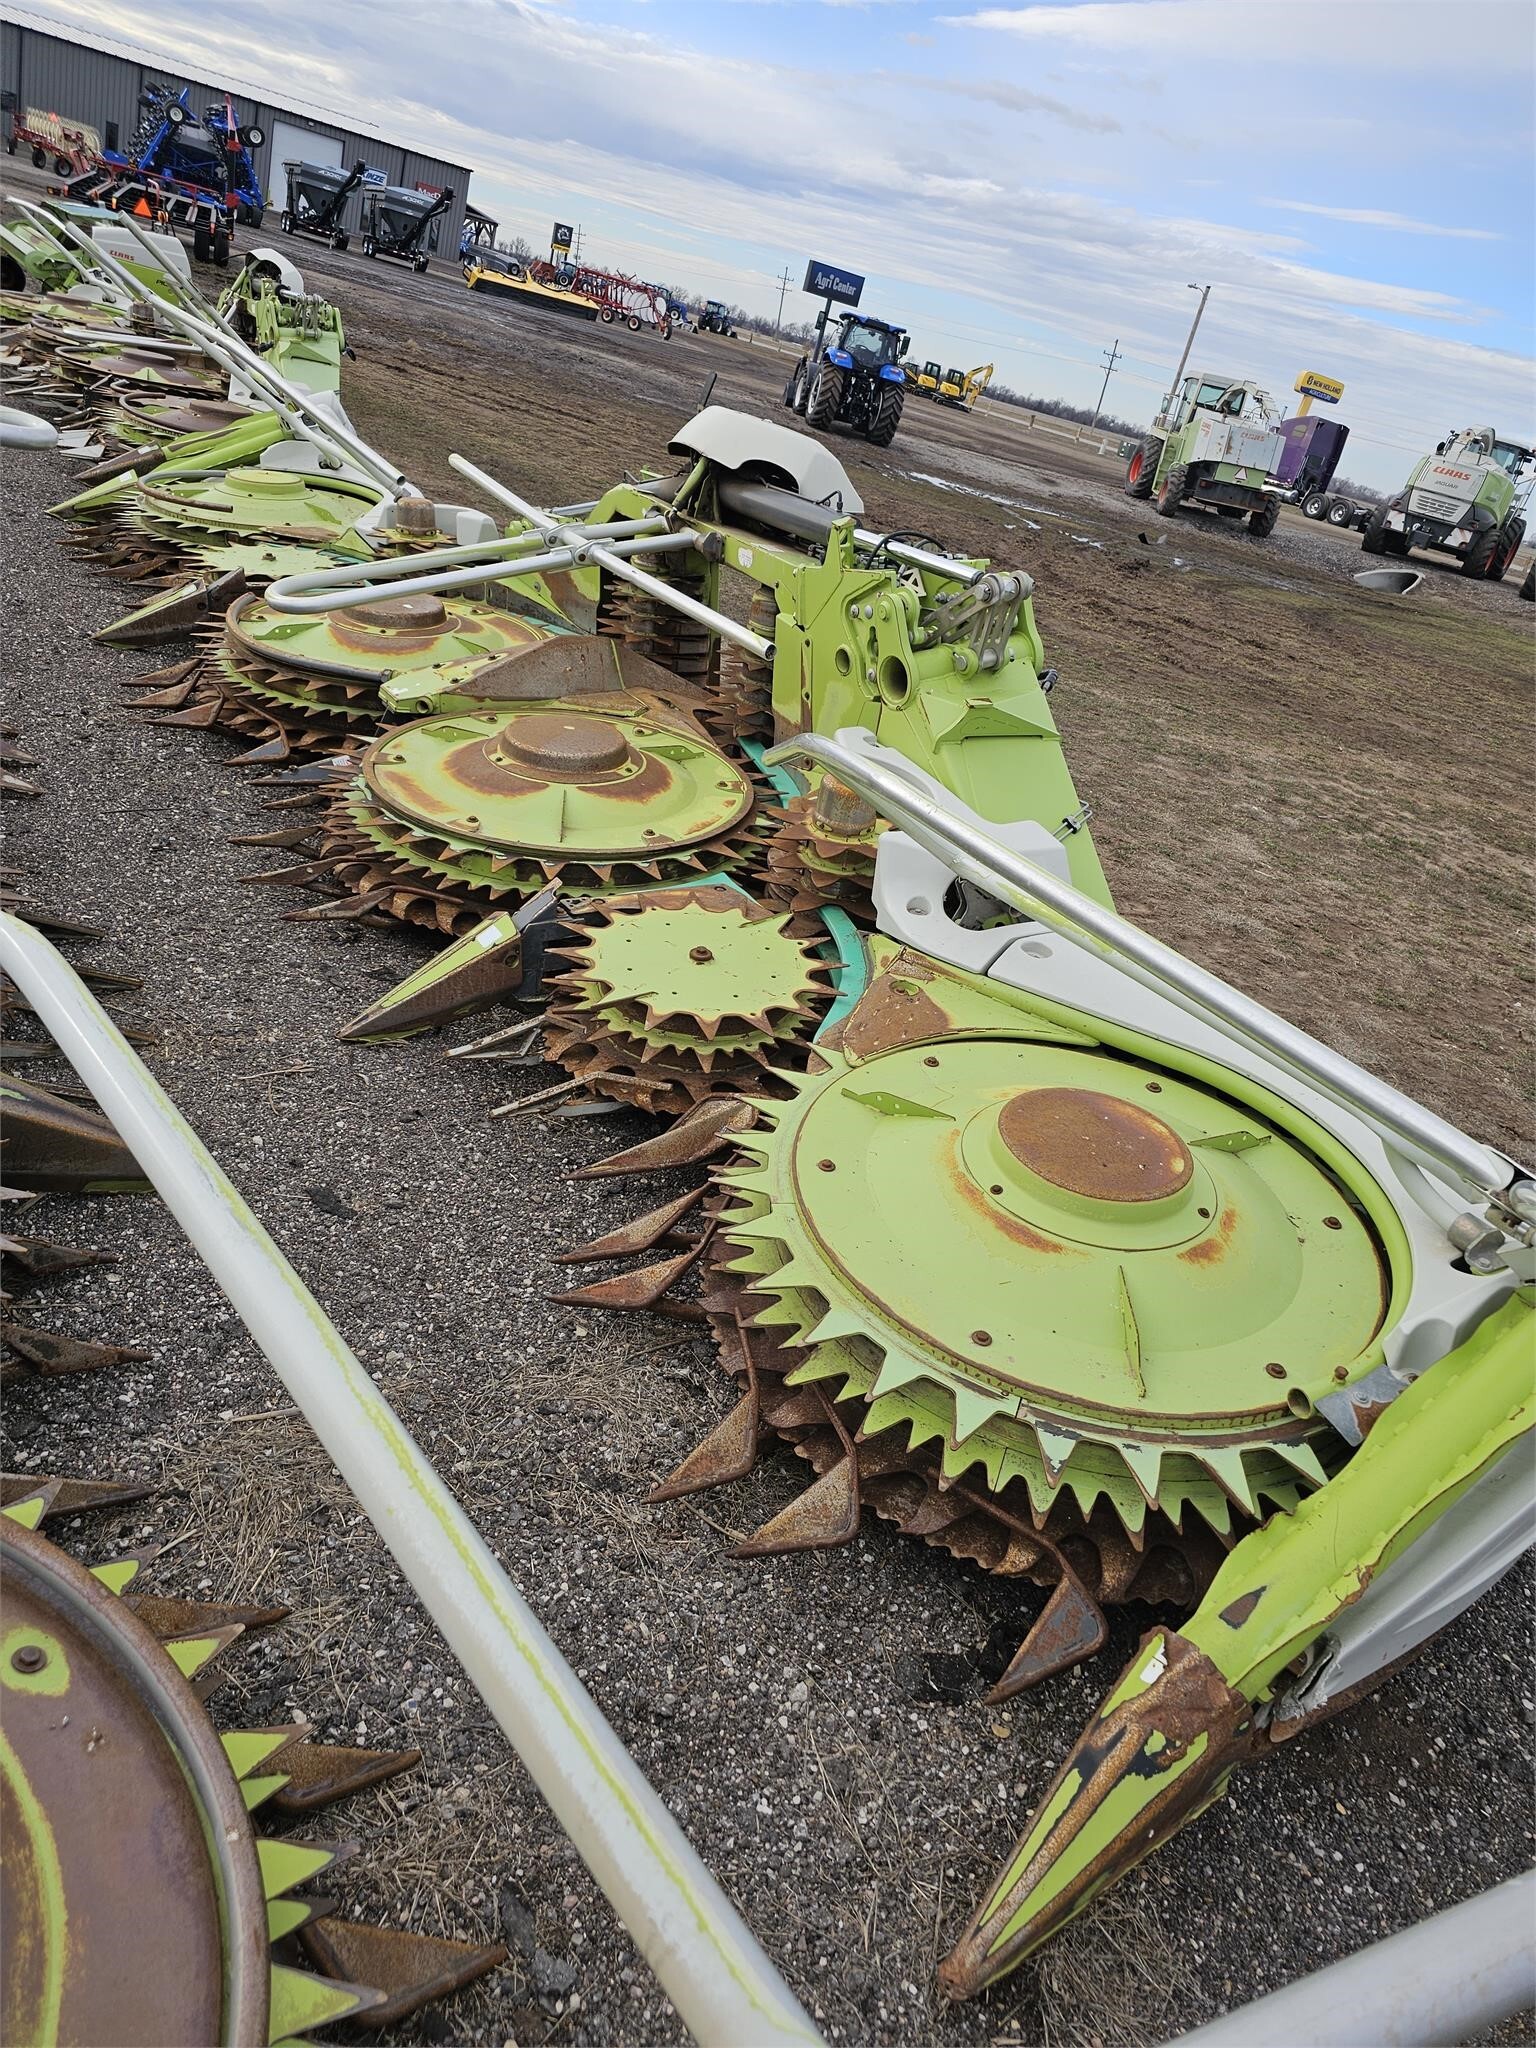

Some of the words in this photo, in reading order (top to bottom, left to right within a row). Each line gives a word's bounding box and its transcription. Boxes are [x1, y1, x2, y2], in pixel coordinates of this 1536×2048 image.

[418, 187, 441, 200] MacD
[110, 250, 135, 261] CLAAS
[814, 272, 834, 290] Agri
[833, 277, 856, 295] Center
[1433, 466, 1471, 480] CLAAS
